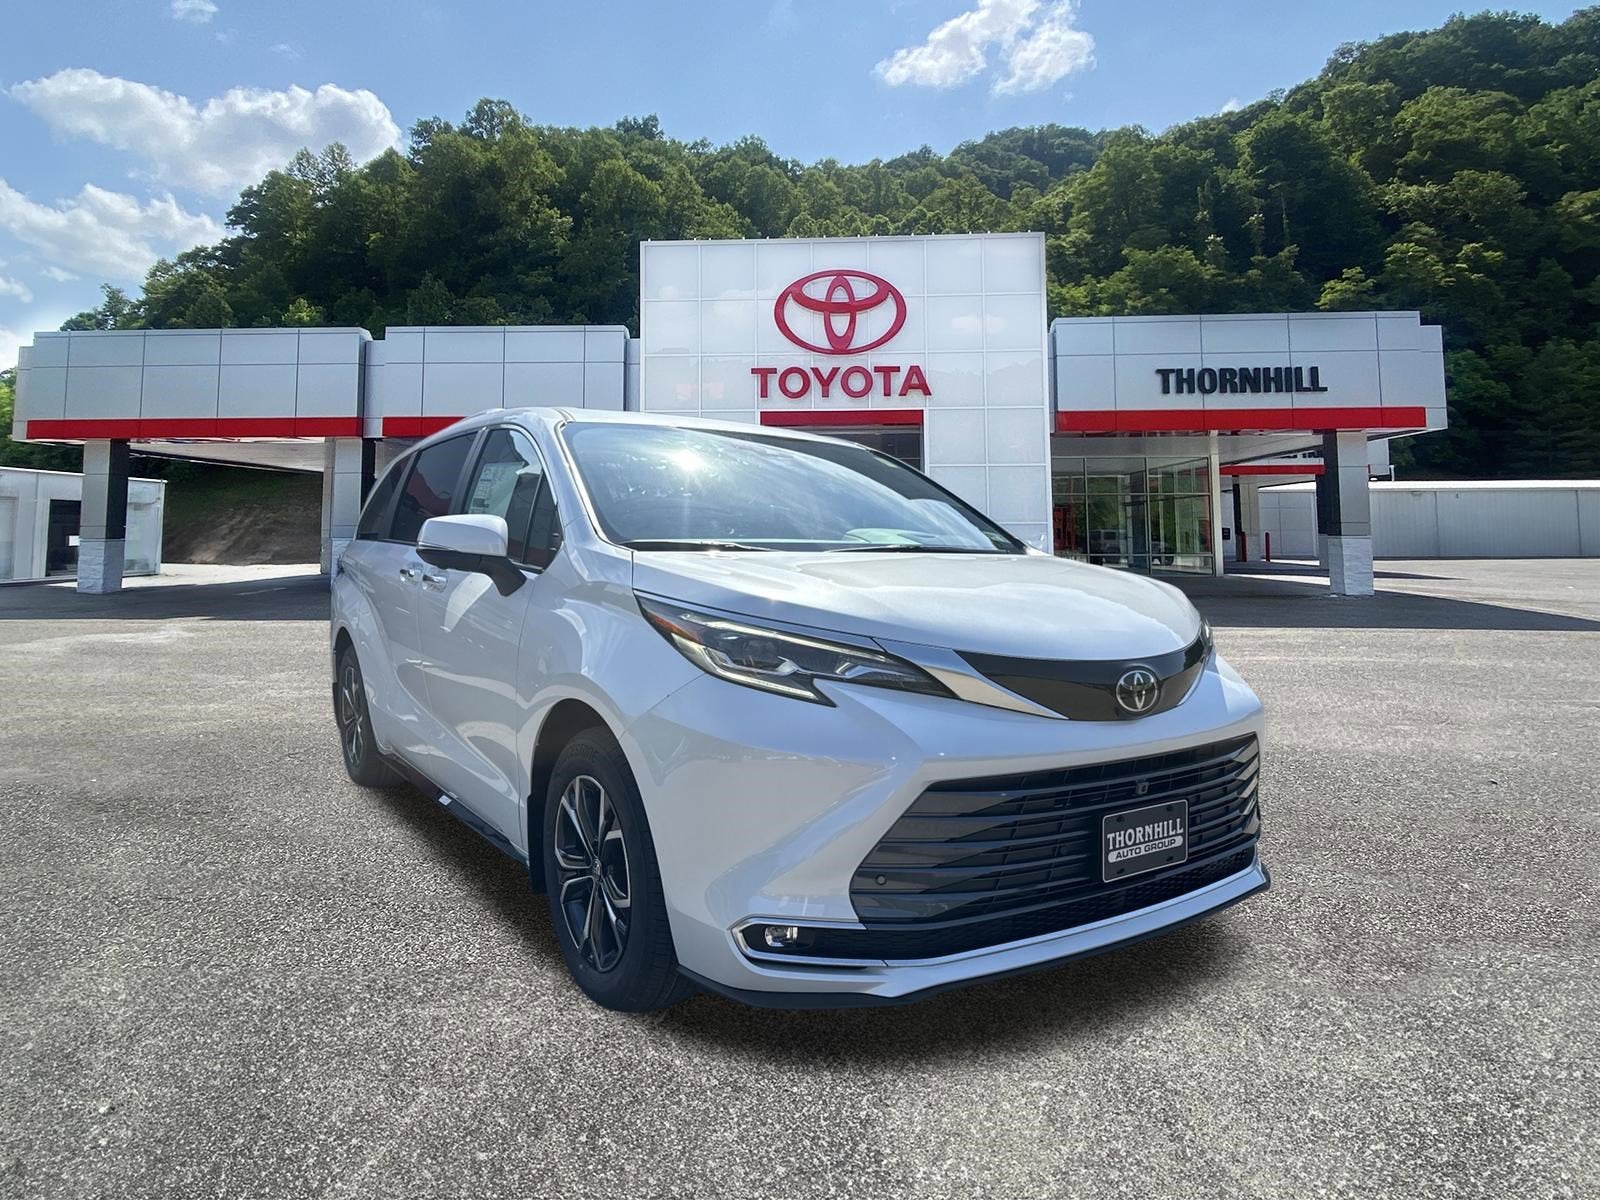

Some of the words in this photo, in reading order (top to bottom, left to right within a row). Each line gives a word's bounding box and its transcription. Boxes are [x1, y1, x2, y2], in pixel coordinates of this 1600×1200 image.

[751, 365, 932, 399] TOYOTA
[1155, 366, 1328, 394] THORNHILL
[1107, 818, 1183, 850] THORNHILL
[1115, 847, 1142, 860] AUTO
[1144, 839, 1176, 852] GROUP
